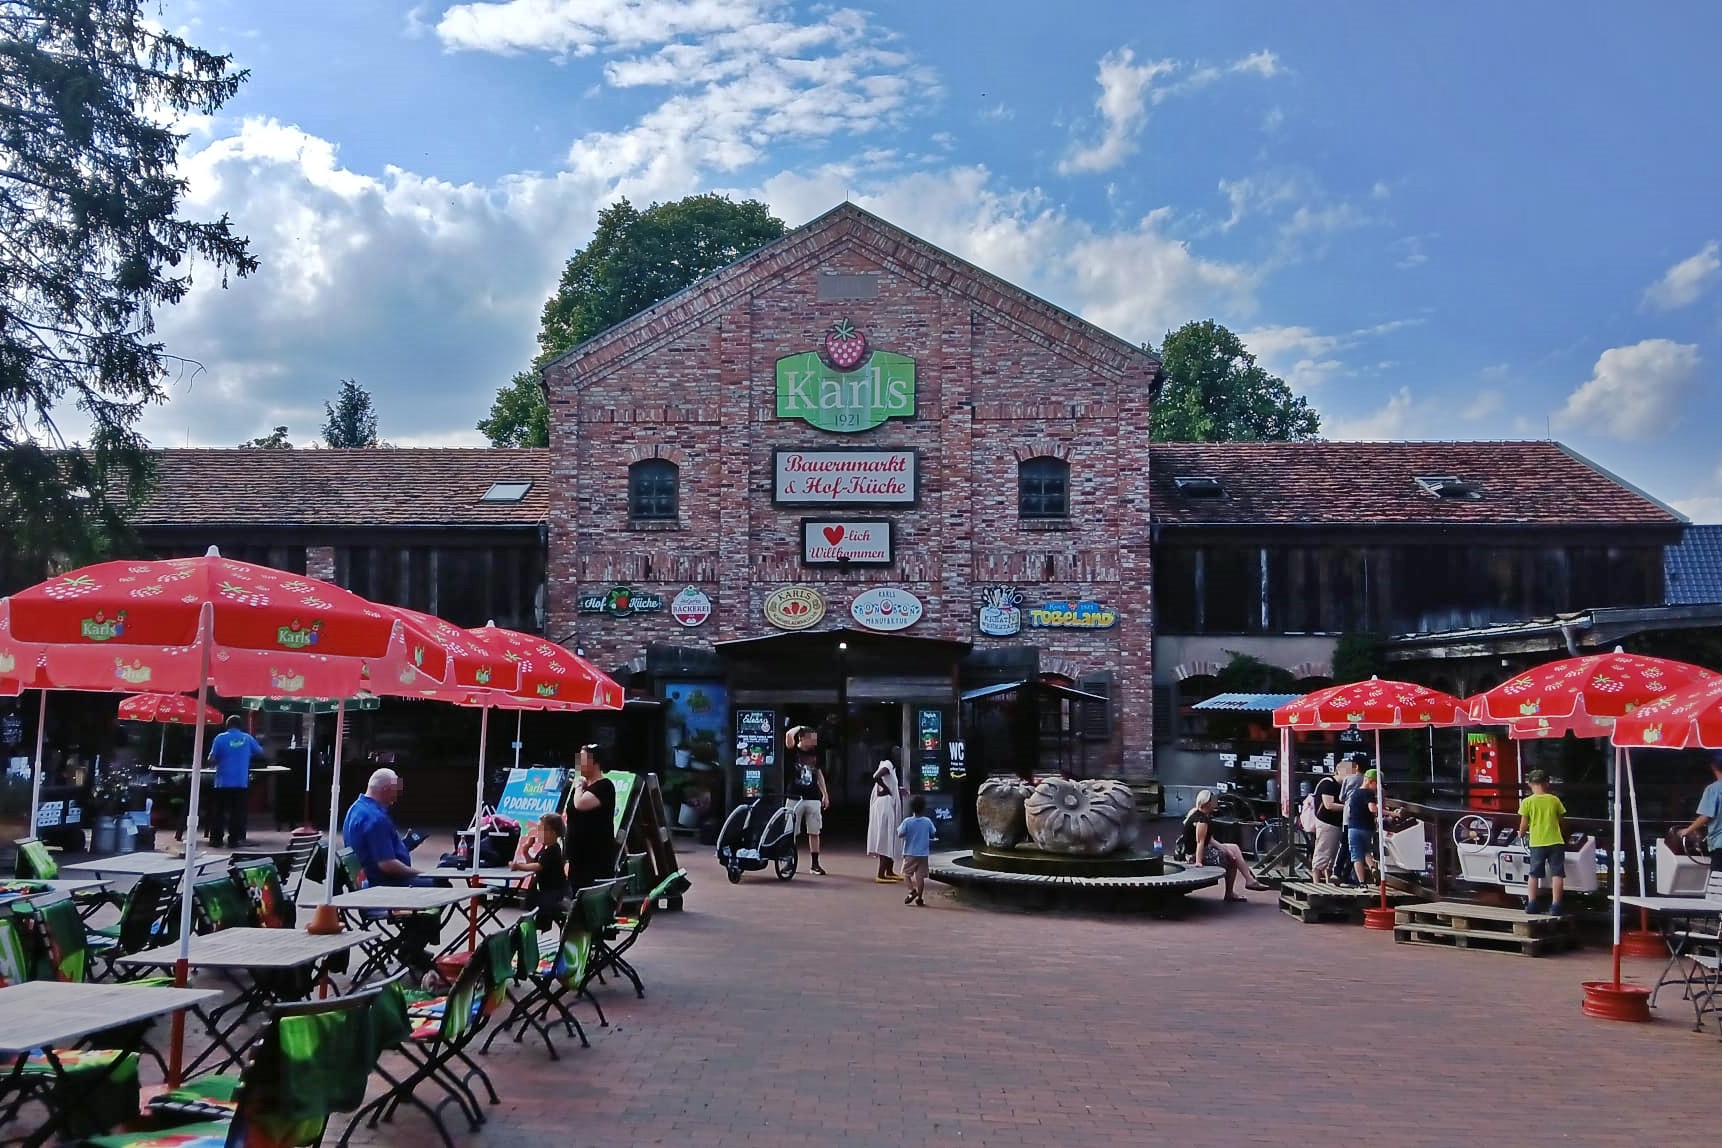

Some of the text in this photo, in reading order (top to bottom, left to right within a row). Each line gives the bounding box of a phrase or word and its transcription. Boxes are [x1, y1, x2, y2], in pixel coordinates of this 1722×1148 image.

[784, 367, 908, 410] Karls
[835, 414, 860, 426] 1921
[784, 454, 906, 472] Bauernmarkt
[784, 476, 906, 499] & Hof-Küche
[809, 547, 885, 559] Willkommen
[628, 597, 659, 608] Küche
[778, 590, 811, 601] KARLS
[584, 597, 607, 612] Hof
[83, 623, 117, 635] Karls
[279, 630, 311, 643] Karls
[948, 741, 965, 761] WC
[509, 796, 555, 812] DORFPLAN
